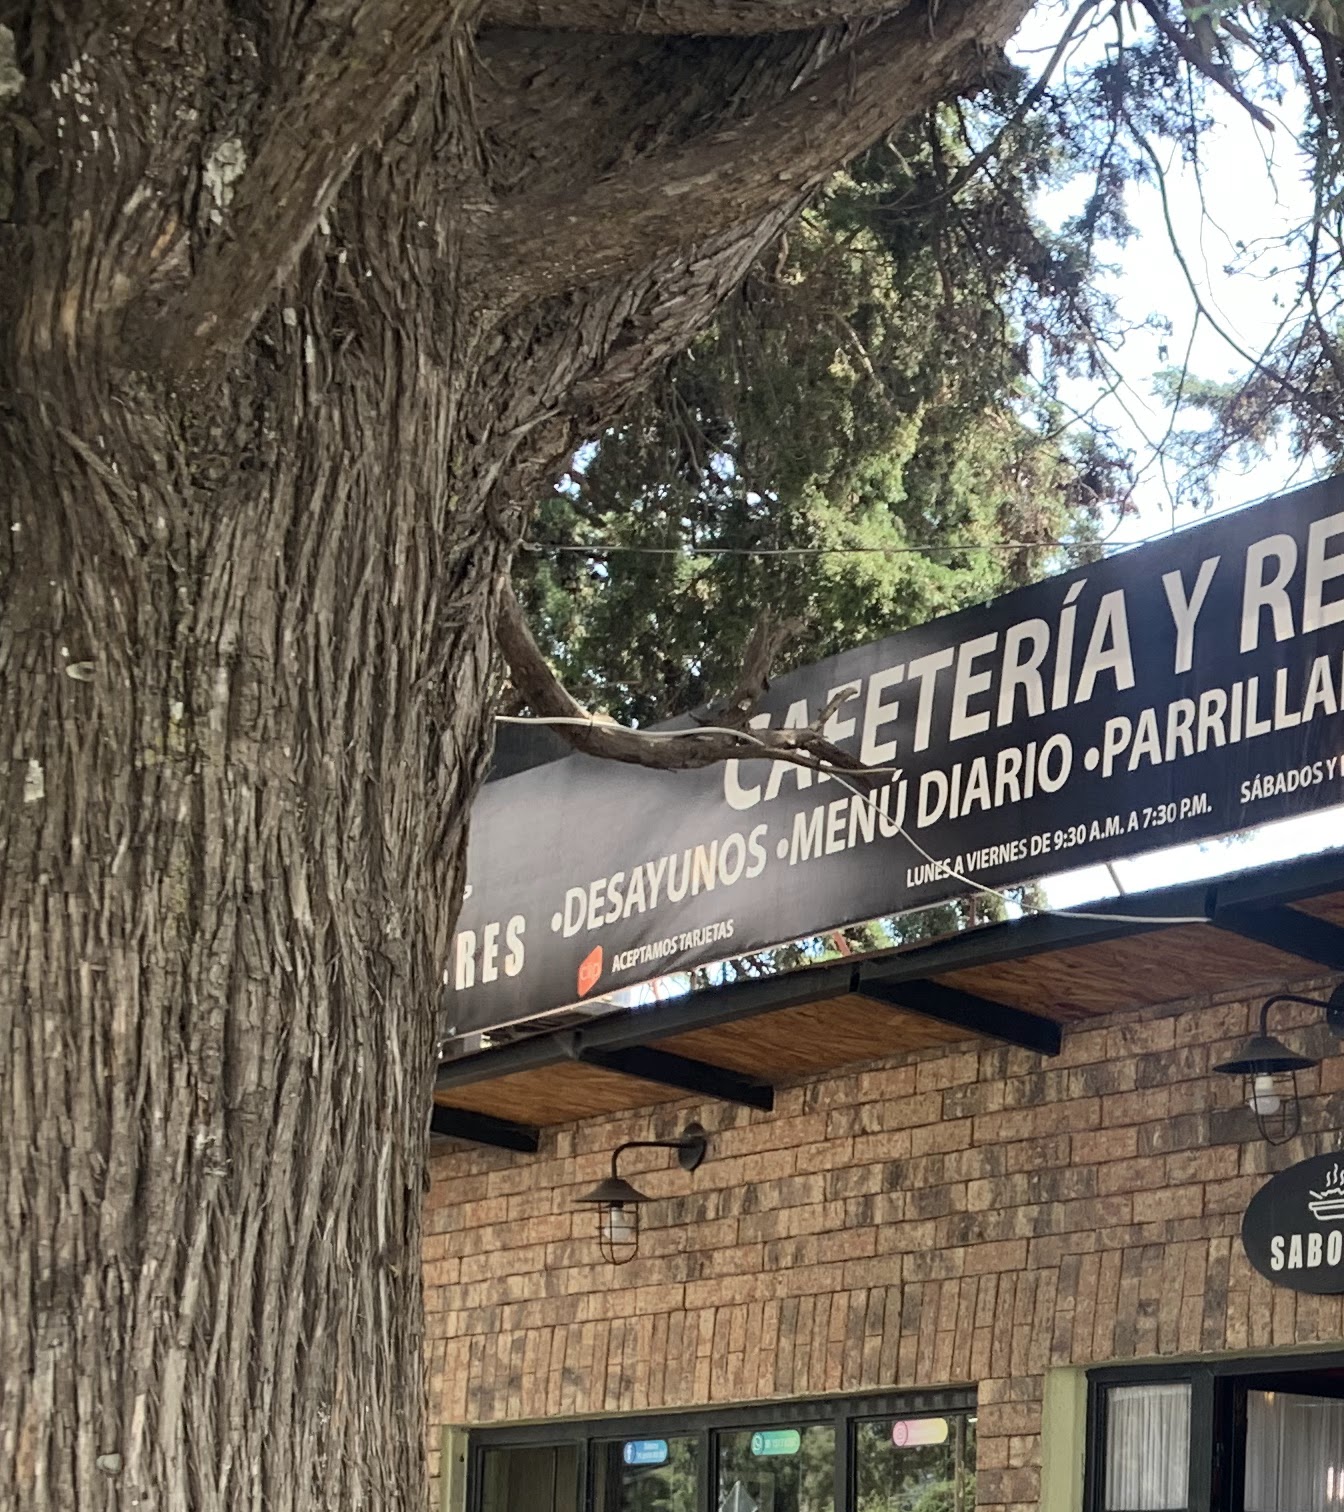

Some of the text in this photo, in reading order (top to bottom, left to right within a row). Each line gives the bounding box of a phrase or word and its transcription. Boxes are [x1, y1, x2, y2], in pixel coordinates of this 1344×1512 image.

[723, 578, 1135, 811] CAFETERÍA
[1162, 555, 1221, 675] Y
[1240, 762, 1324, 803] SÁBADOS
[1325, 758, 1338, 782] Y
[563, 824, 768, 938] DESAYUNOS
[789, 767, 908, 865] MENÚ
[916, 733, 1073, 829] DIARIO
[906, 793, 1213, 888] LUNES A VIERNES DE 9:30 A.M. A 7:30 P.M.
[612, 918, 735, 972] ACEPTAMOS TARJETAS
